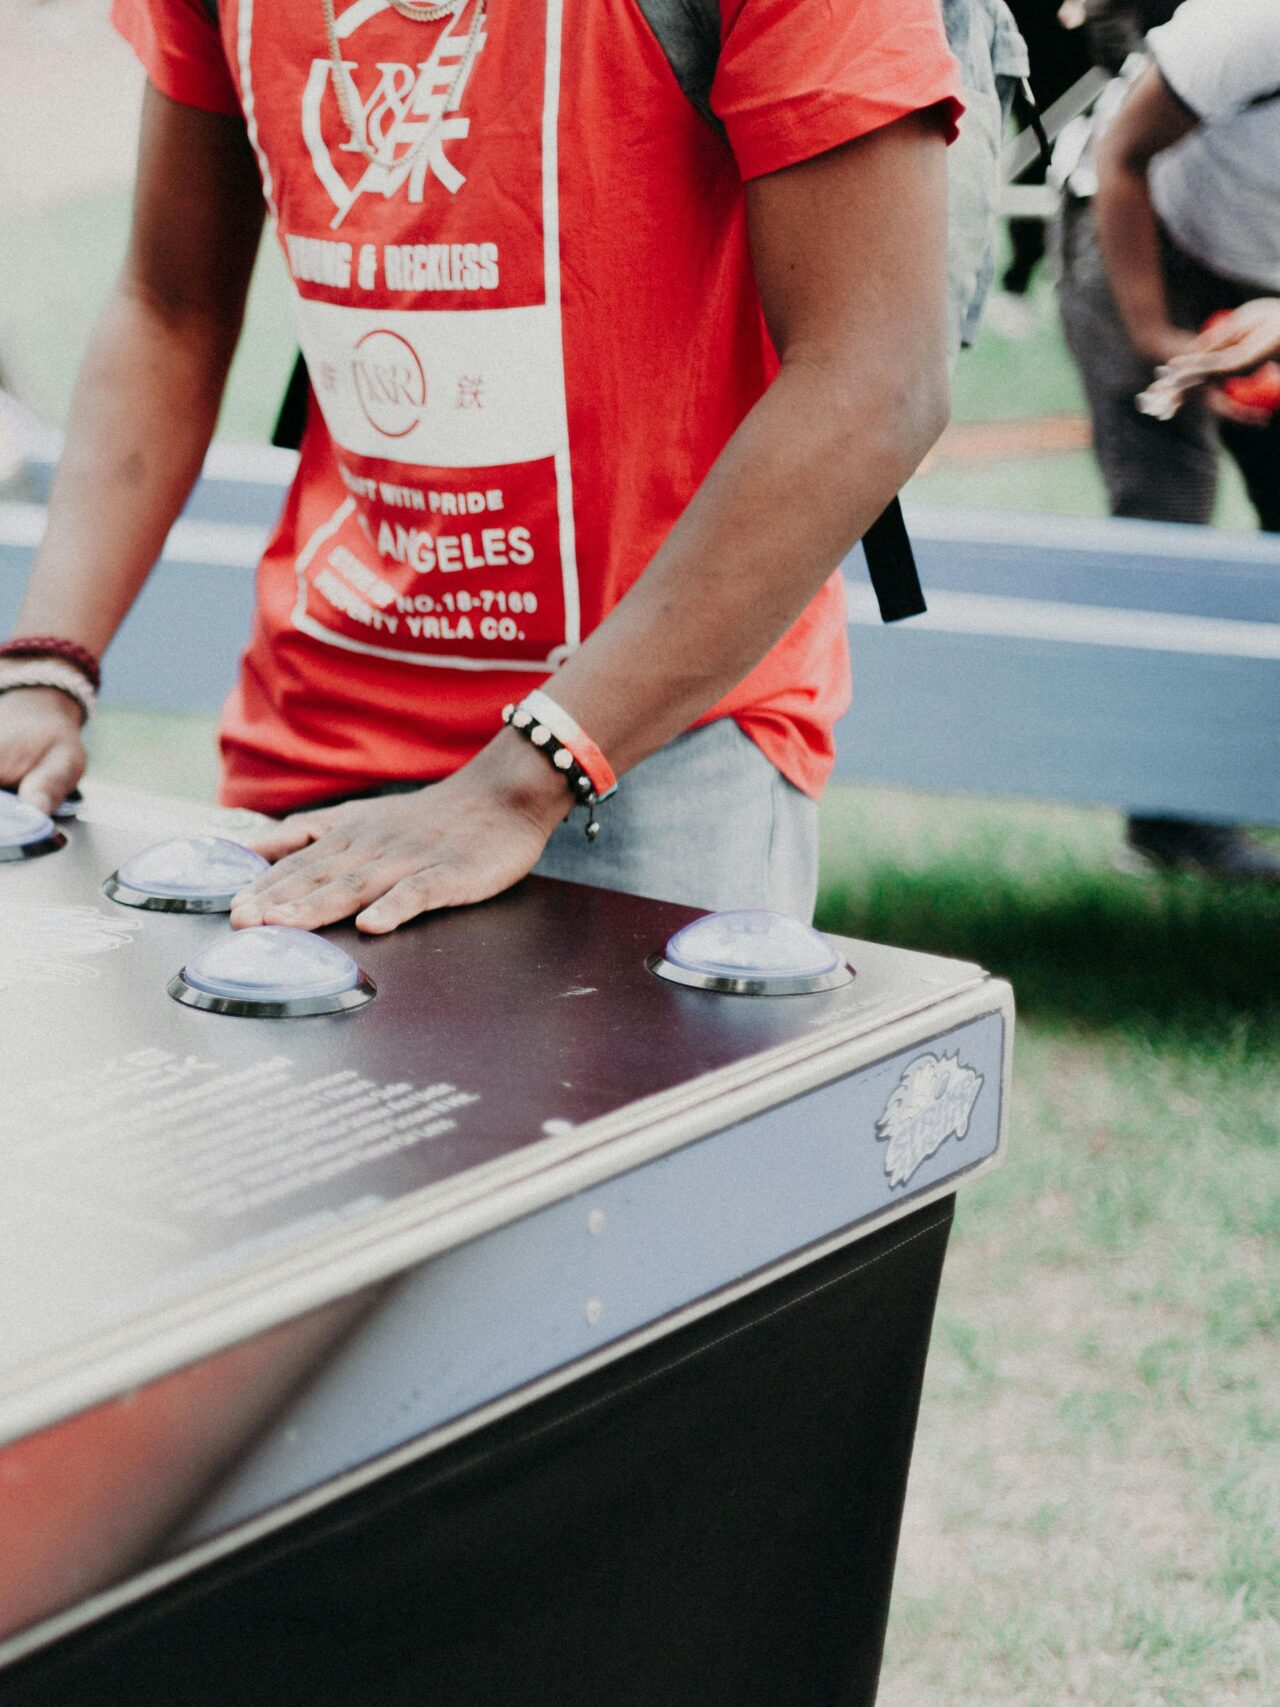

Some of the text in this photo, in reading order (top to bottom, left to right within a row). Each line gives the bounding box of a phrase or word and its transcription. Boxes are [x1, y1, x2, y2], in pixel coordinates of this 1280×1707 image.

[384, 242, 500, 291] RECKLESS
[428, 489, 504, 515] PRIDE
[377, 520, 535, 573] ANGELES
[480, 617, 526, 641] CO.
